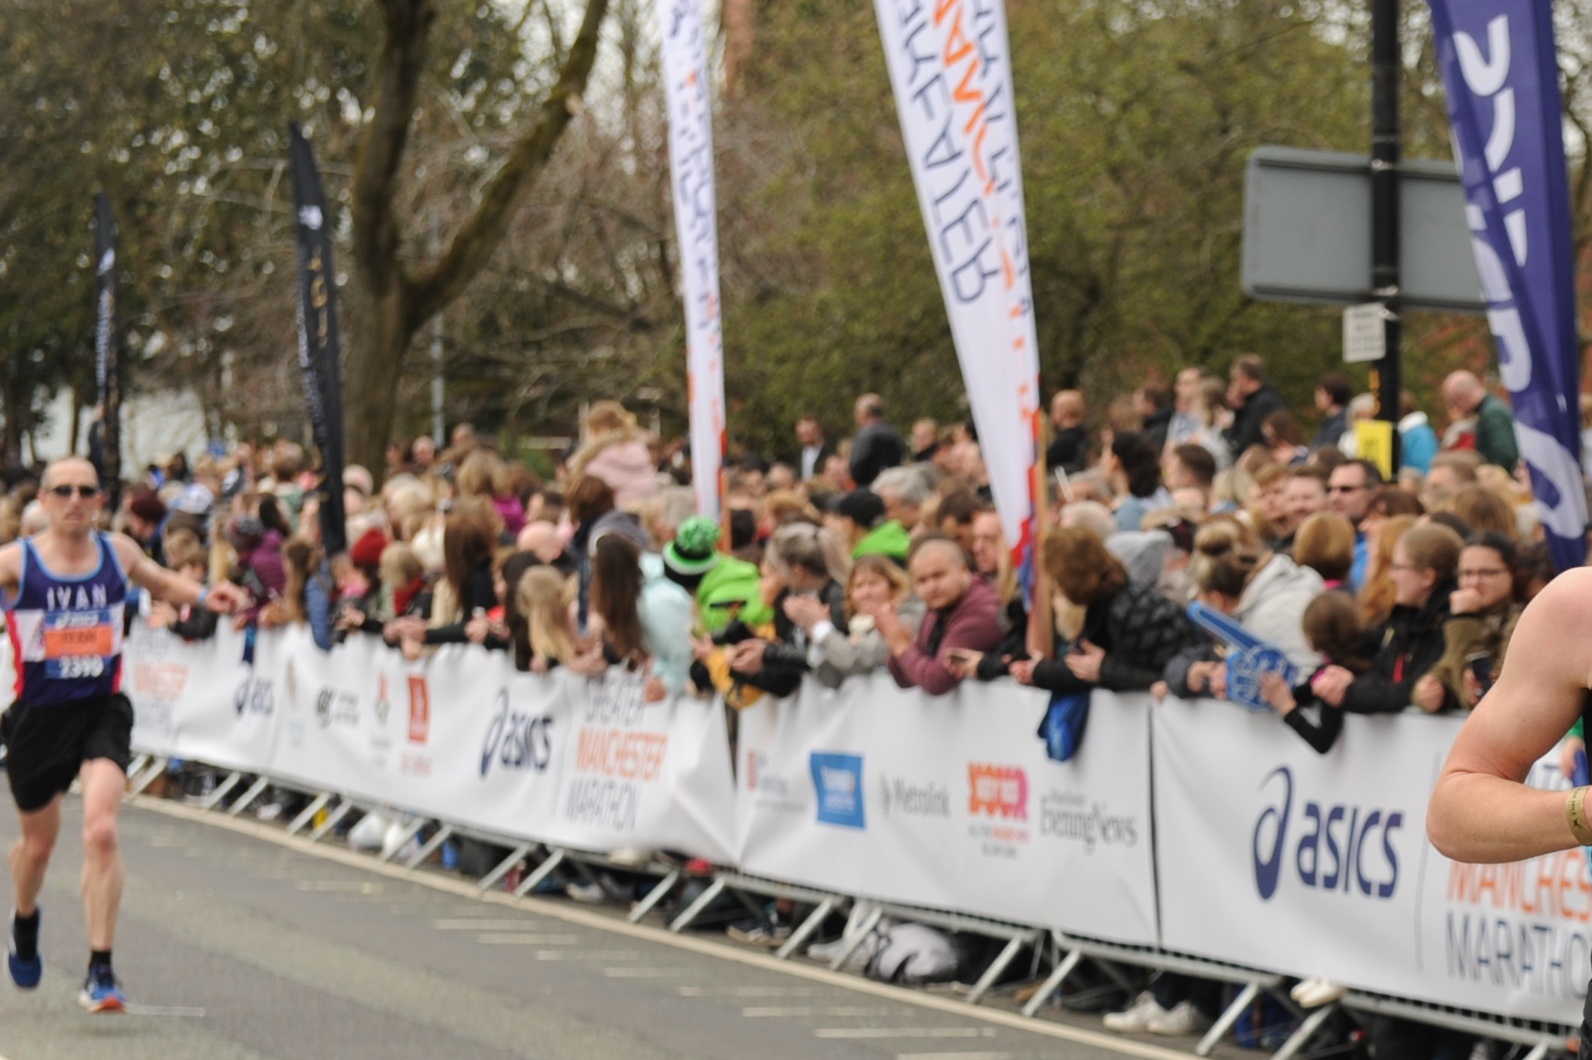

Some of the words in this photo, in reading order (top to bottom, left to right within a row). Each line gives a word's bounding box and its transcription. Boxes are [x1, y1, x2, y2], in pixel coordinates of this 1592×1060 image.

[47, 584, 107, 611] IVAN
[1297, 802, 1404, 898] asics
[1446, 911, 1592, 998] MARATHO
